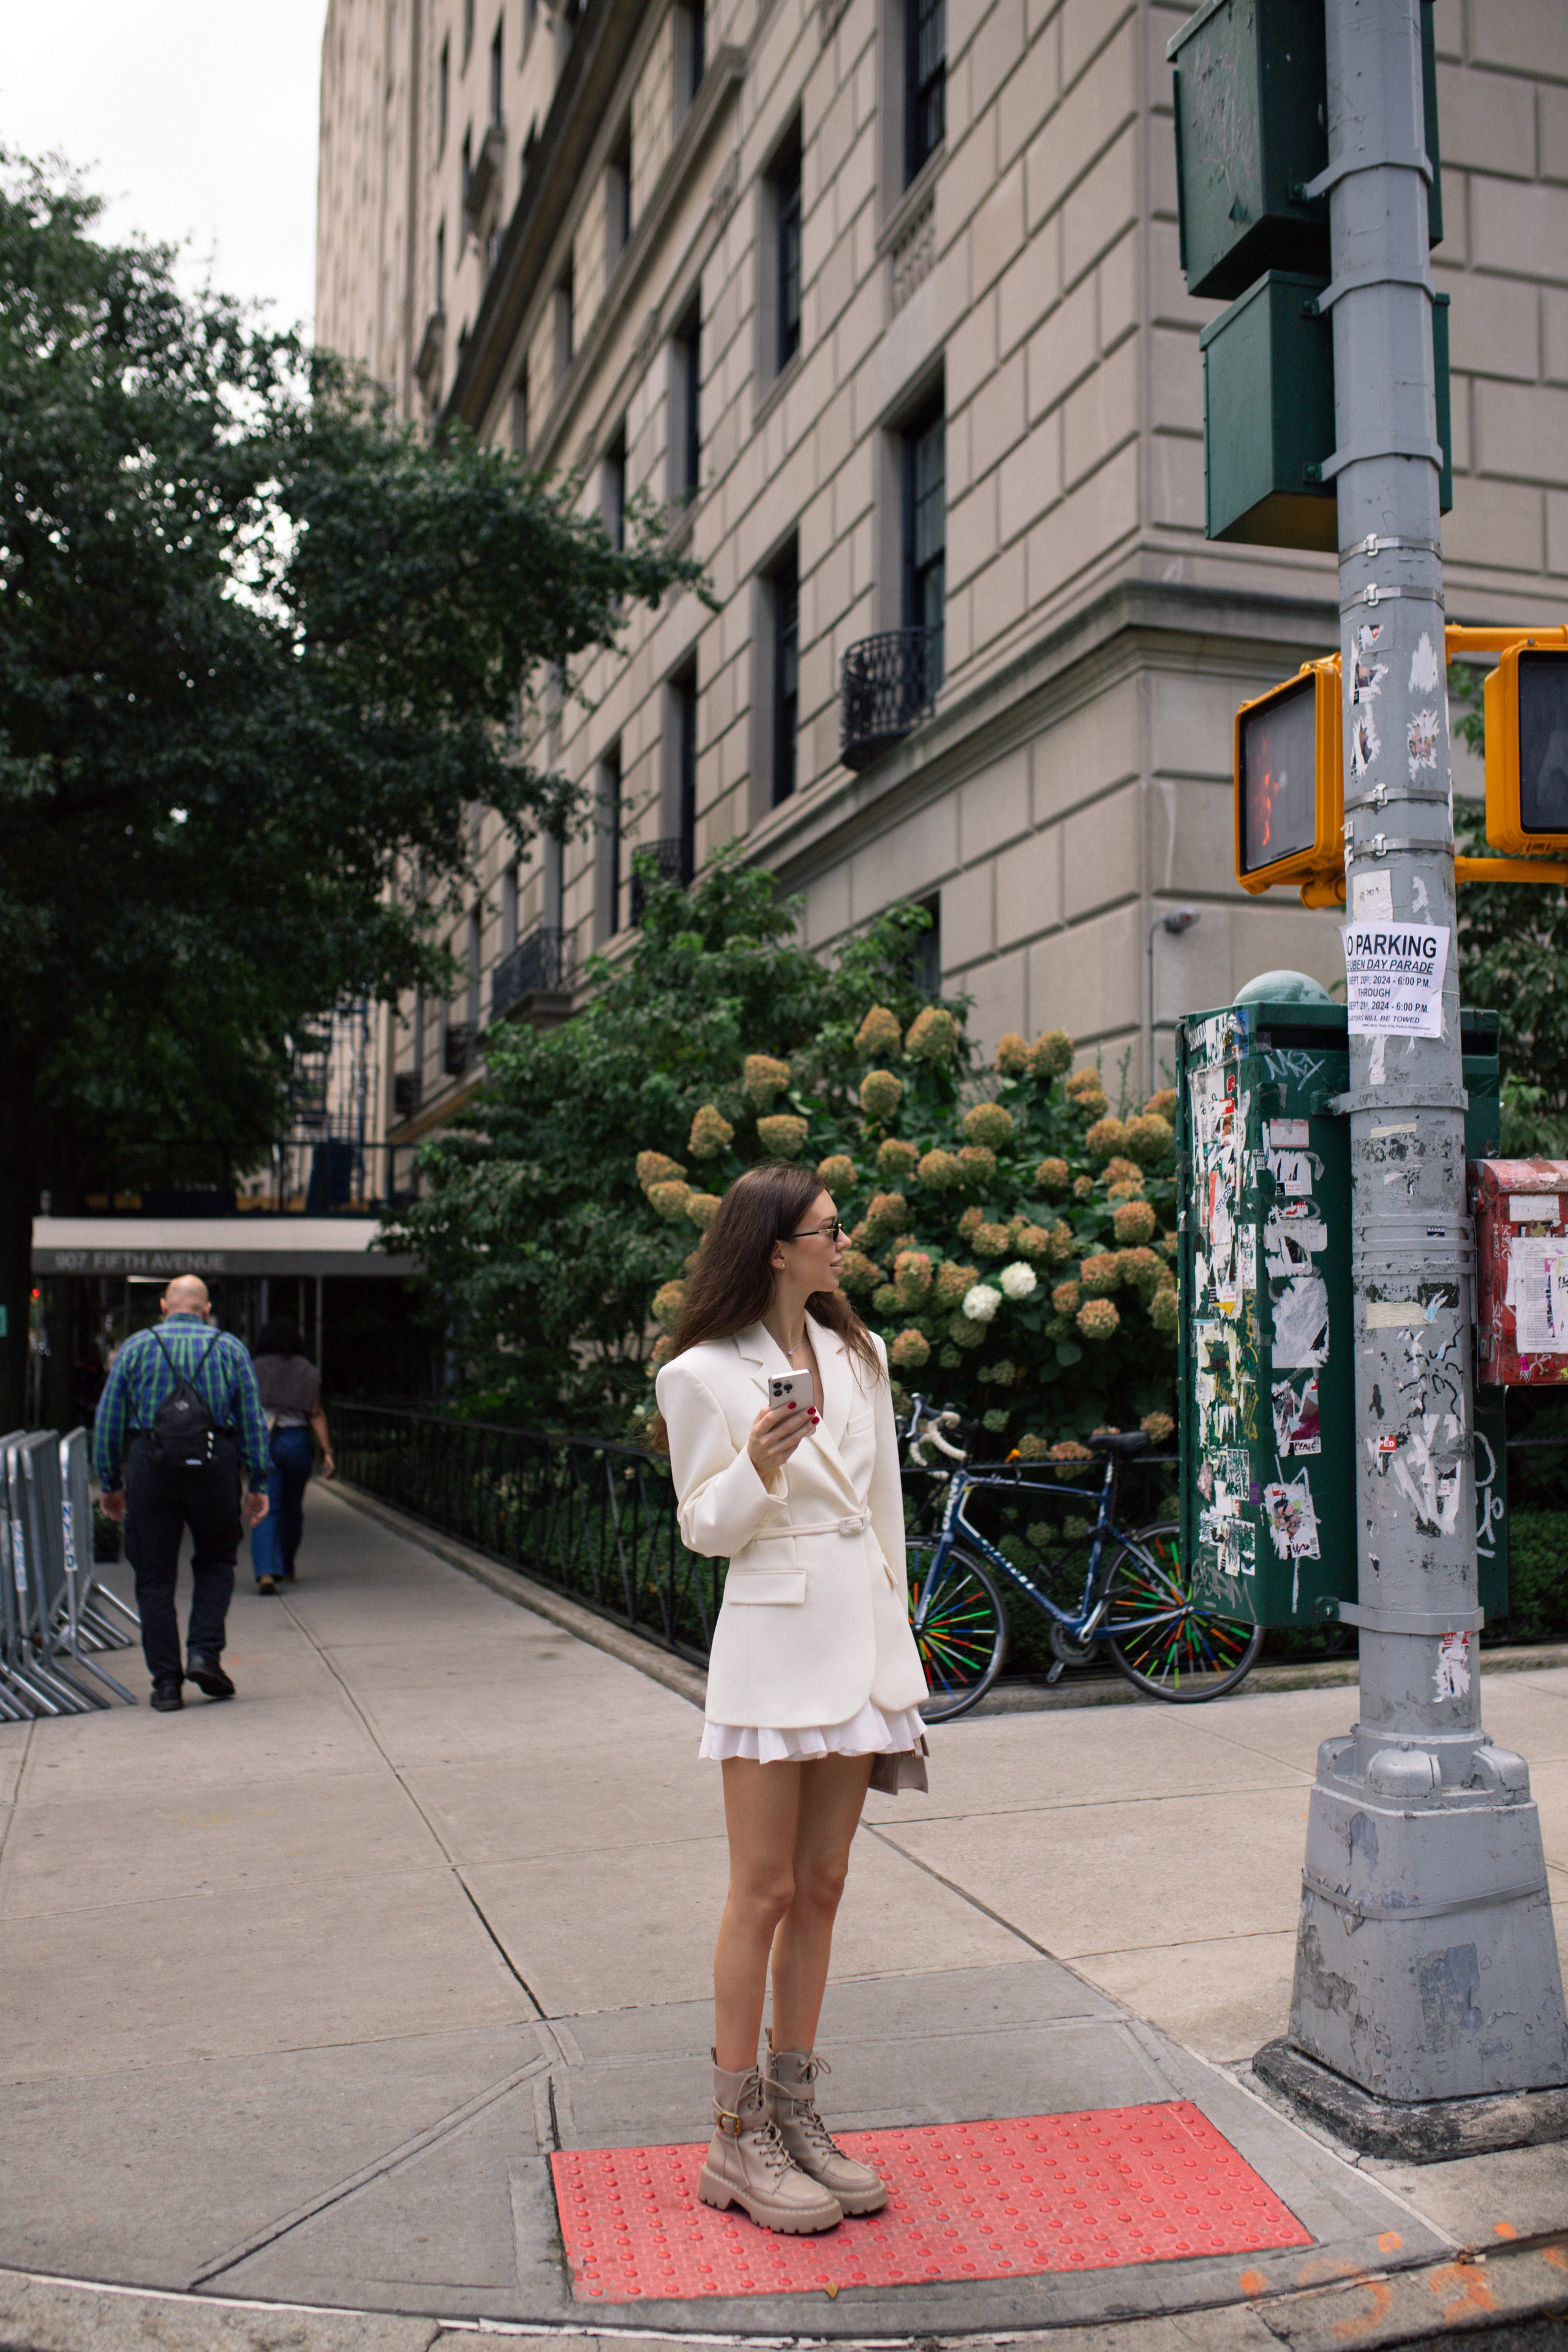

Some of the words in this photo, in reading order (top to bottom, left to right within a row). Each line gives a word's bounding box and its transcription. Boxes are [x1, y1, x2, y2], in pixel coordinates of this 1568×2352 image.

[1347, 935, 1354, 956] O
[1356, 934, 1437, 959] PARKING
[1347, 960, 1365, 971] EUBEN
[1366, 959, 1388, 970] DAY
[1389, 960, 1434, 973] PARADE
[1373, 976, 1390, 984] 2024
[1398, 976, 1414, 986] 6:00
[1416, 978, 1430, 988] P.M.
[1358, 988, 1390, 997] THROUGH
[1371, 1001, 1389, 1010] 2024
[1396, 1002, 1413, 1011] 6:00
[1415, 1003, 1430, 1014] P.M.
[1215, 1185, 1232, 1214] STUDS
[55, 1252, 87, 1270] 907
[94, 1251, 148, 1270] FIFTH
[151, 1252, 225, 1271] AVENUE
